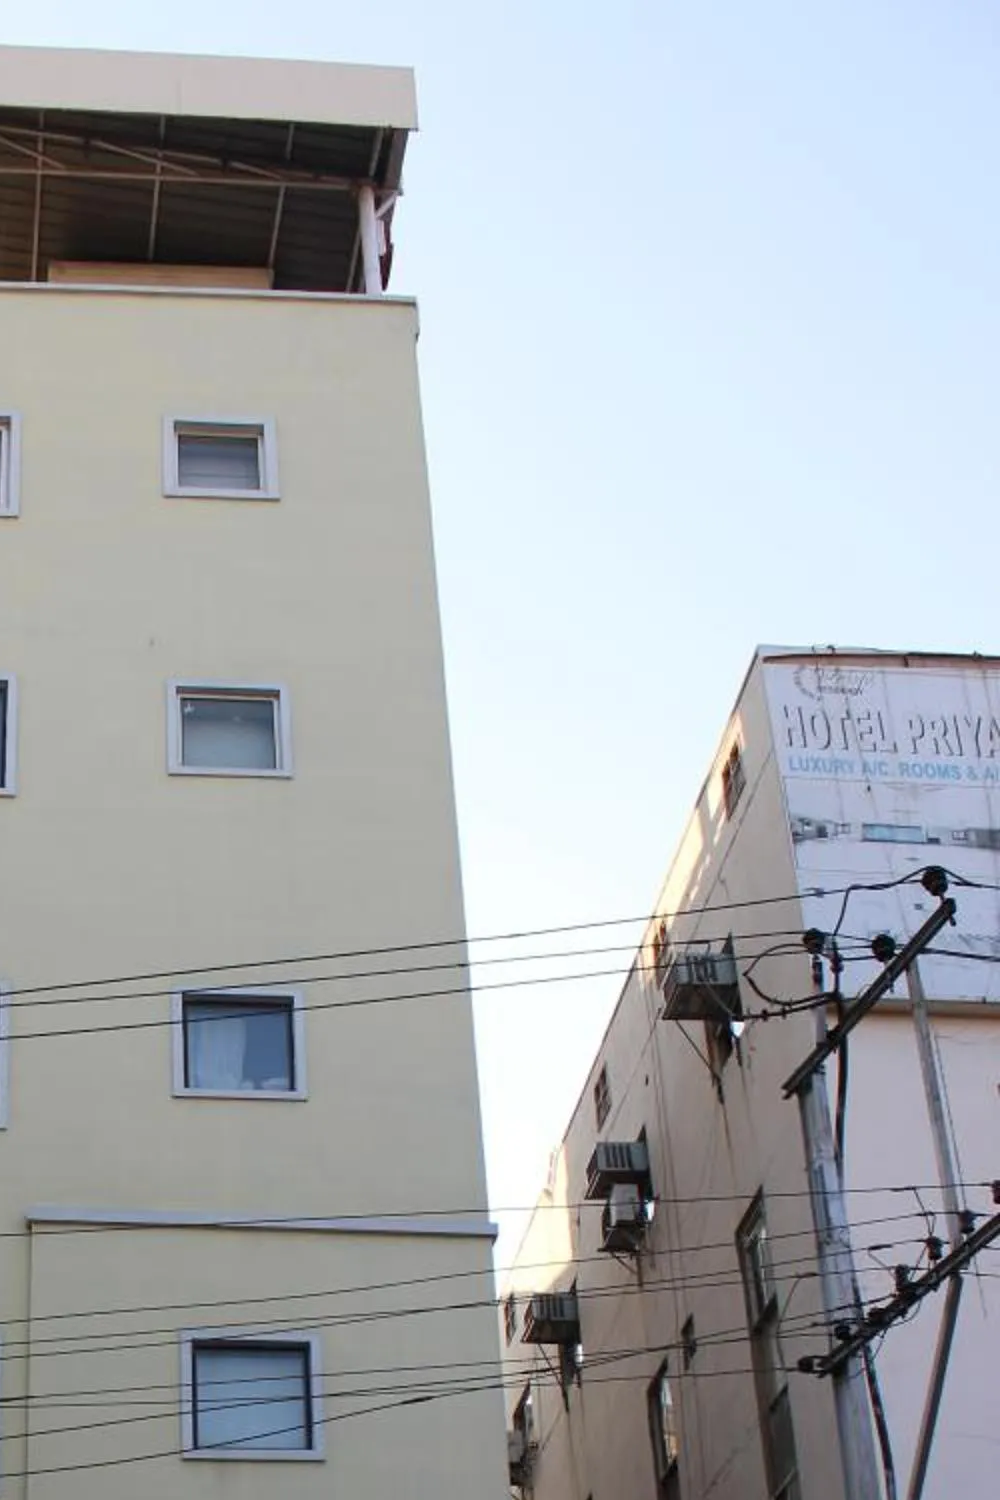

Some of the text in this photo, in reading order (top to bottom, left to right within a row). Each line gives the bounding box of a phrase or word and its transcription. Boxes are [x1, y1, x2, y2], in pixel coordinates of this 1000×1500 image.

[783, 704, 898, 754] HOTEL
[788, 754, 853, 773] LUXURY
[900, 761, 961, 779] ROOMS
